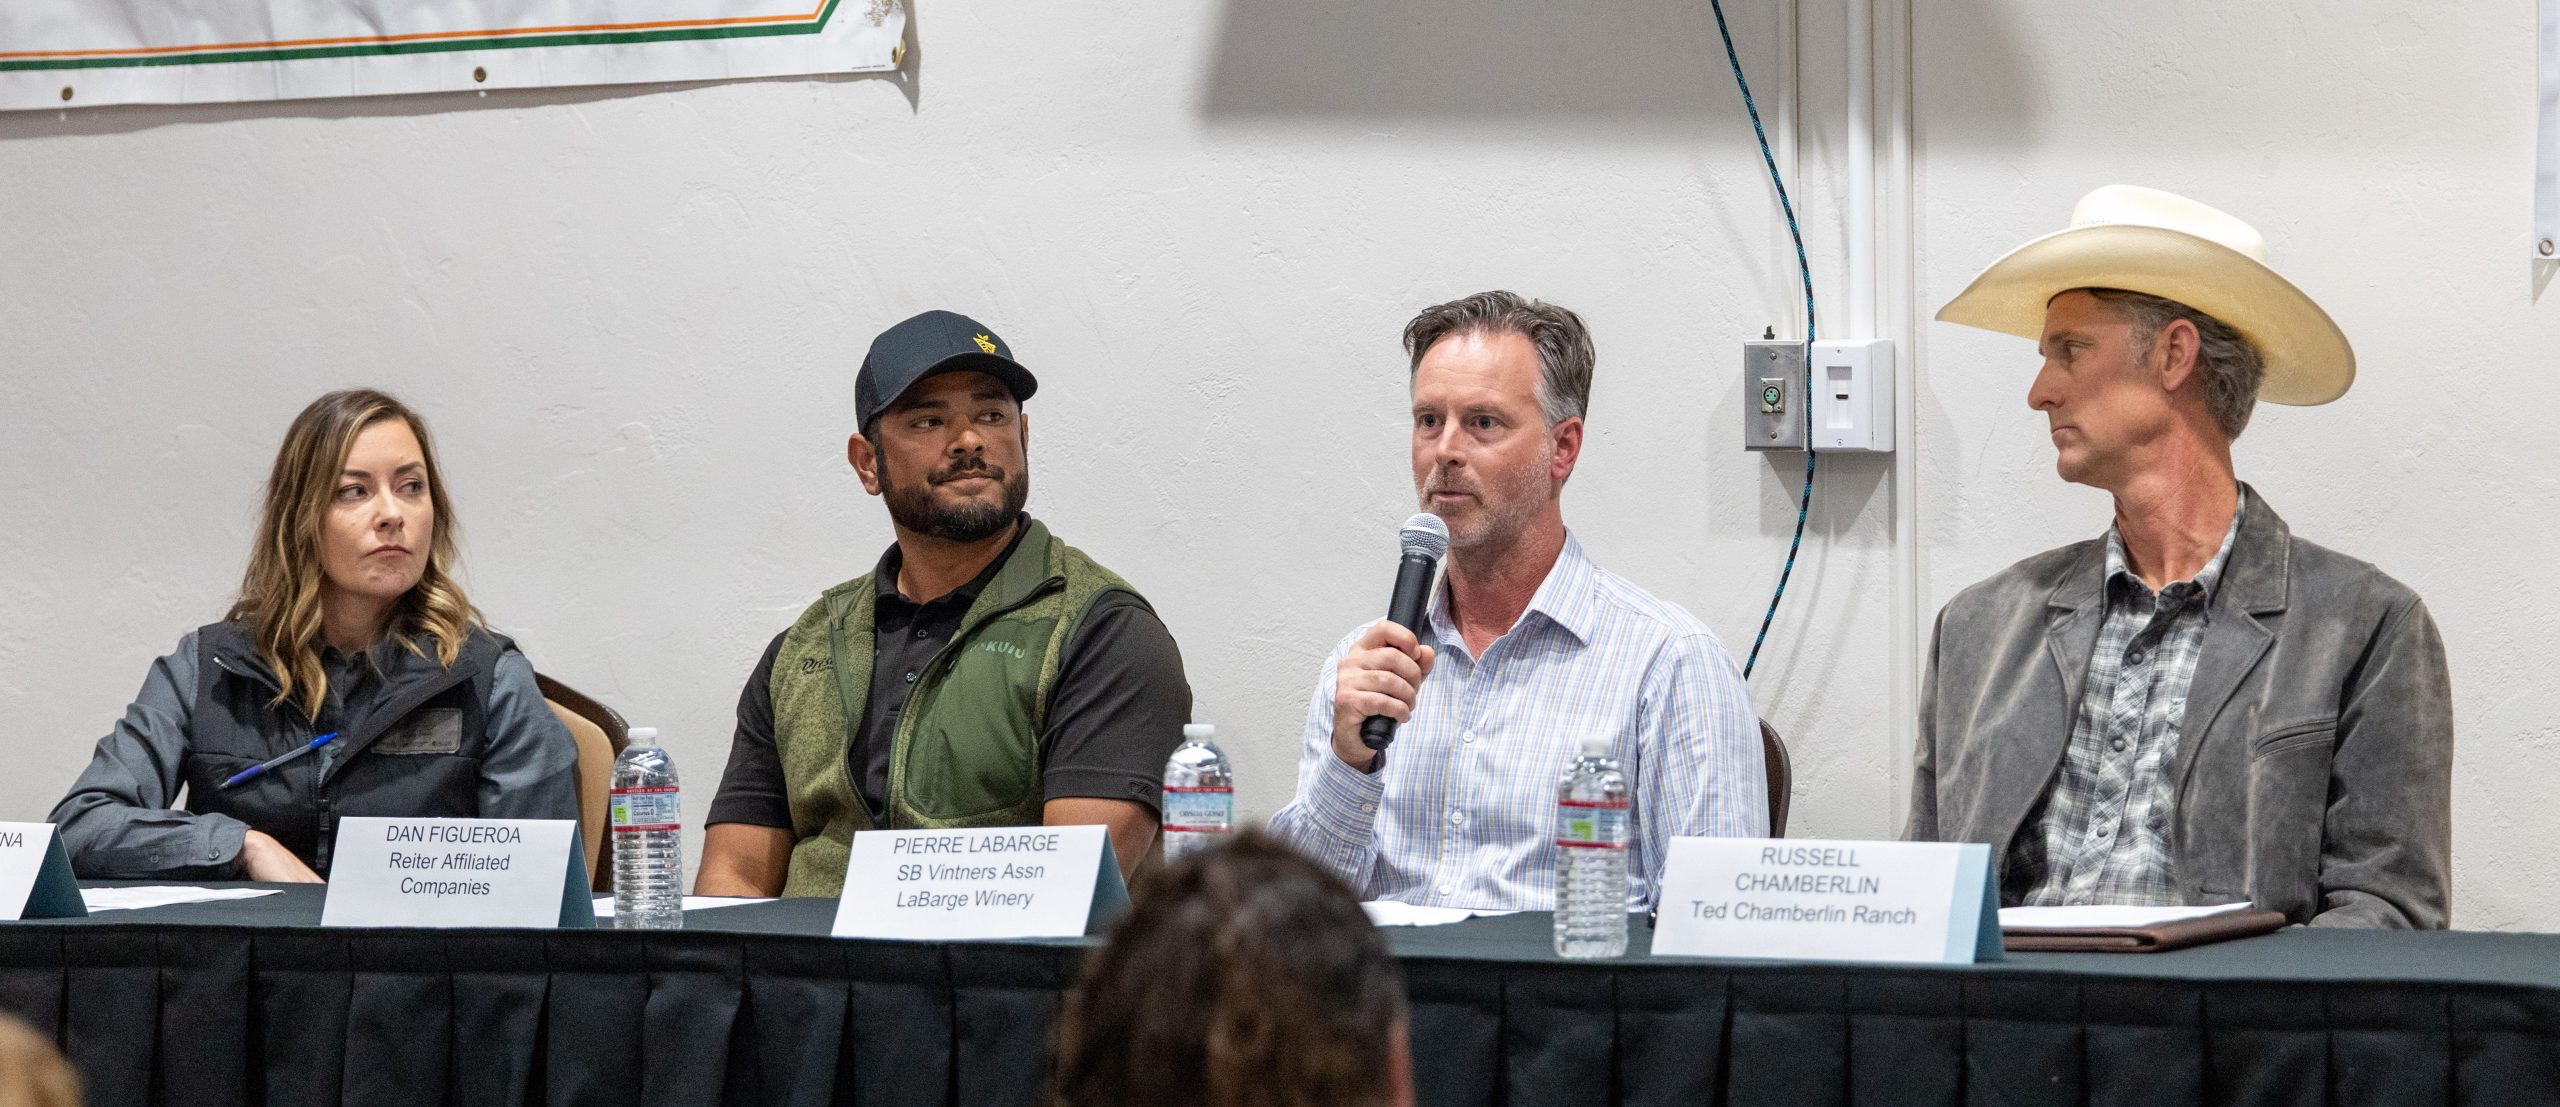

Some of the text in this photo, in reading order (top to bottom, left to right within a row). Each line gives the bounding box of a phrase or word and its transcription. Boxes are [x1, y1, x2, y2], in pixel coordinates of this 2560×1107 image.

[0, 831, 23, 848] NA
[386, 825, 521, 844] DAN FIGUEROA
[893, 834, 1060, 855] PIERRE LABARGE
[389, 851, 511, 871] Reiter Affiliated
[1760, 846, 1861, 868] RUSSELL
[896, 862, 1045, 882] SB Vintners Assn
[400, 876, 491, 899] Companies
[1734, 872, 1880, 895] CHAMBERLIN
[896, 888, 1034, 911] LaBarge Winery
[1691, 900, 1917, 926] Ted Chamberlin Ranch
